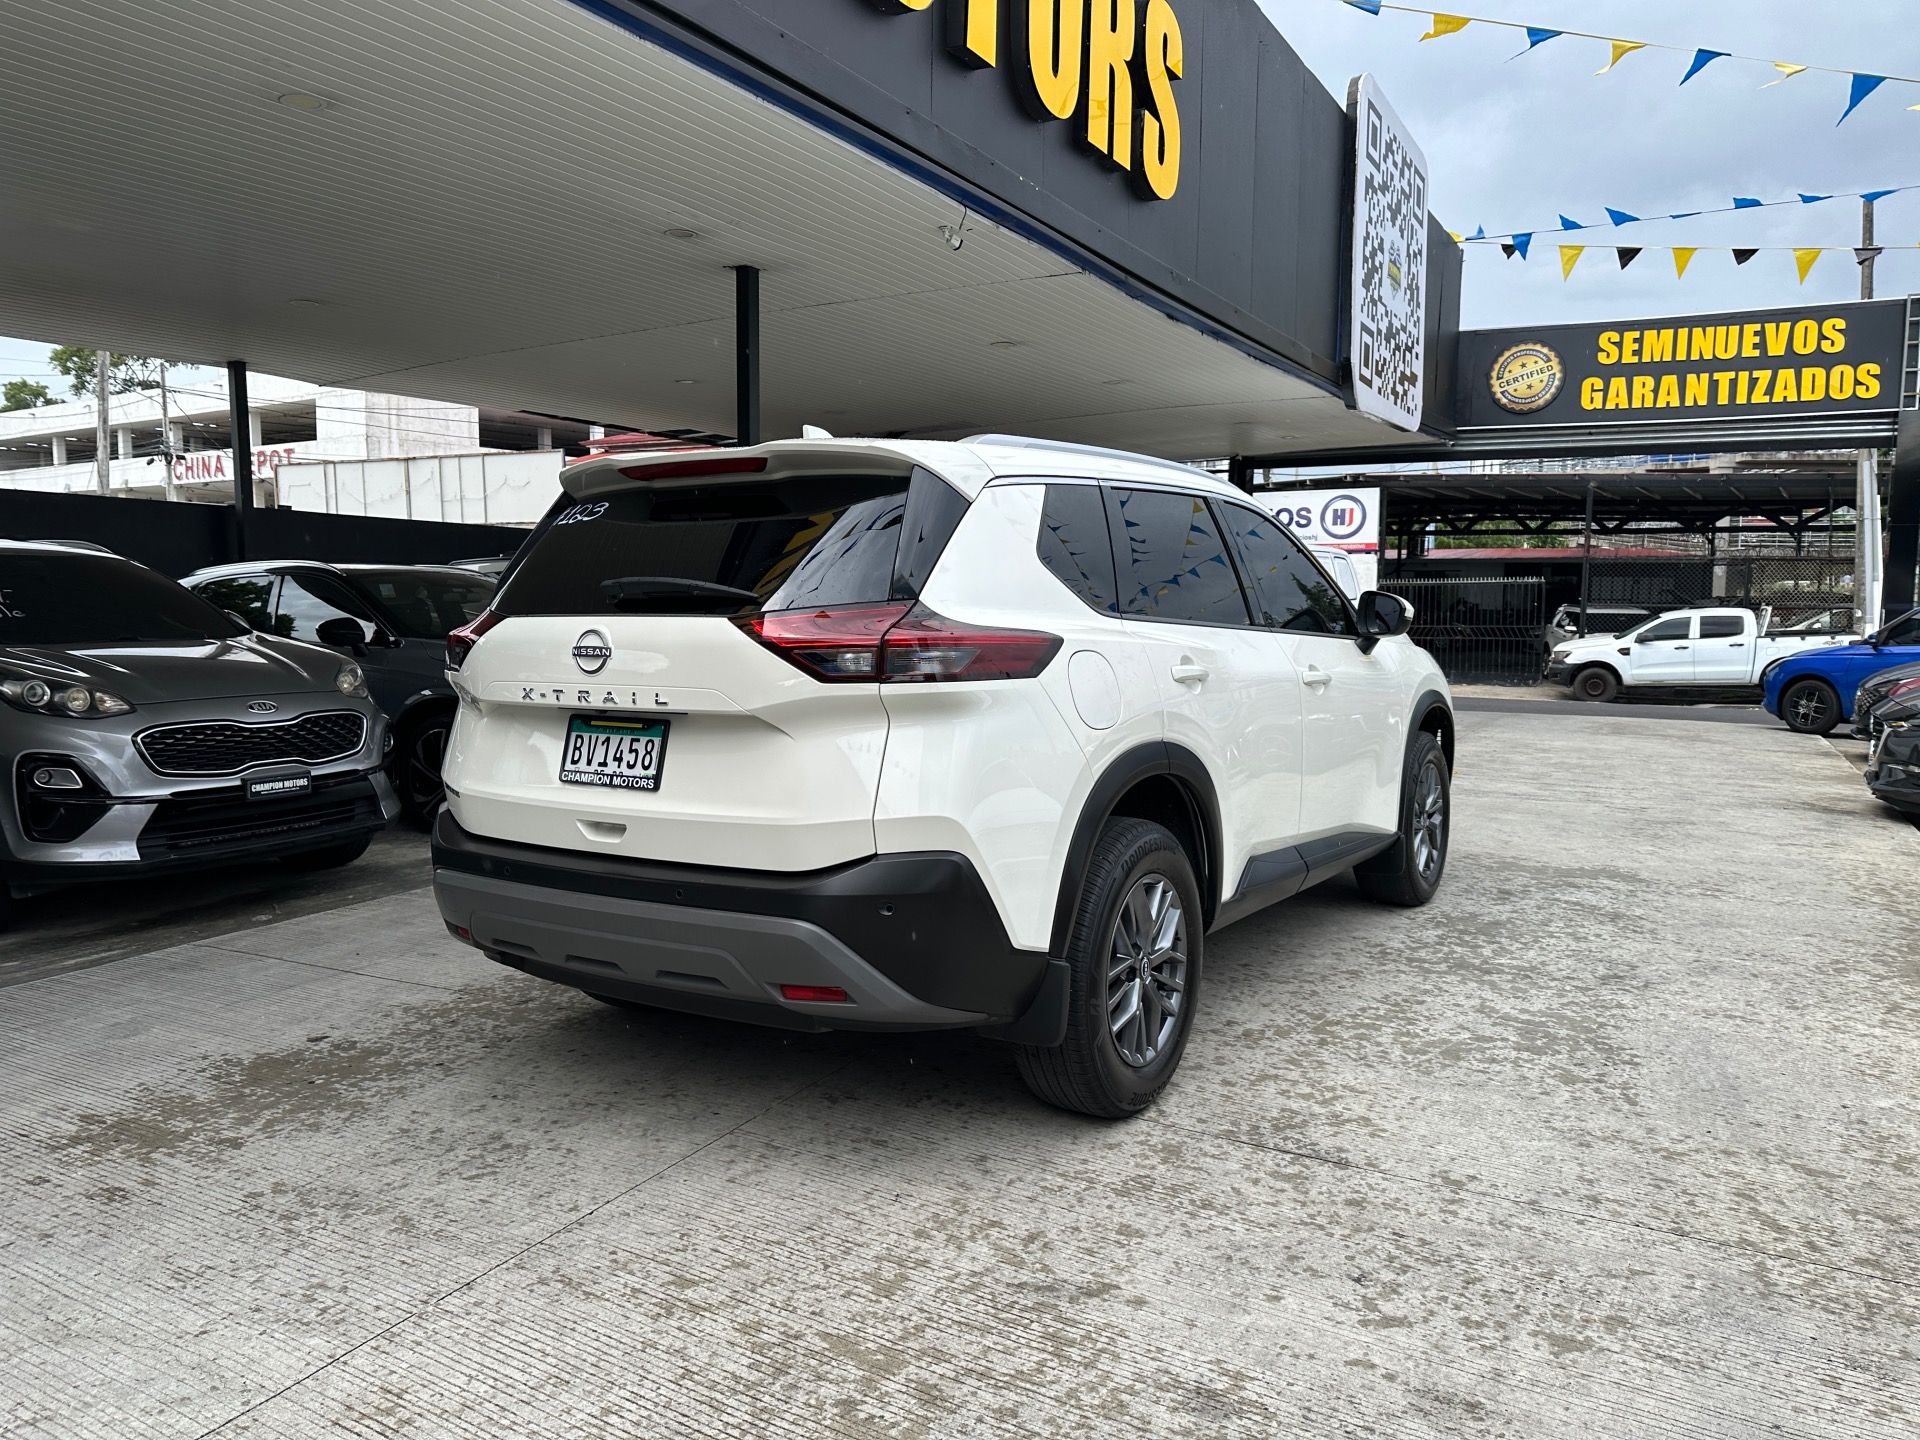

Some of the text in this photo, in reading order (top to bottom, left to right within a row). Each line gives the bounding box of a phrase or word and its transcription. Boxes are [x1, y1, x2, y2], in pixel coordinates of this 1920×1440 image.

[1597, 317, 1847, 365] SEMINUEVOS
[1498, 364, 1554, 389] CERTIFIED
[1580, 362, 1881, 410] GARANTIZADOS
[173, 454, 226, 481] CHINA
[1269, 506, 1312, 528] OS
[572, 647, 610, 657] NISSAN
[522, 686, 668, 705] X-TRAIL
[251, 702, 275, 712] KIA
[570, 733, 655, 771] BV1458
[251, 780, 283, 792] CHAMPION
[283, 778, 309, 788] MOTORS
[561, 771, 610, 785] CHAMPION
[612, 776, 655, 789] MOTORS
